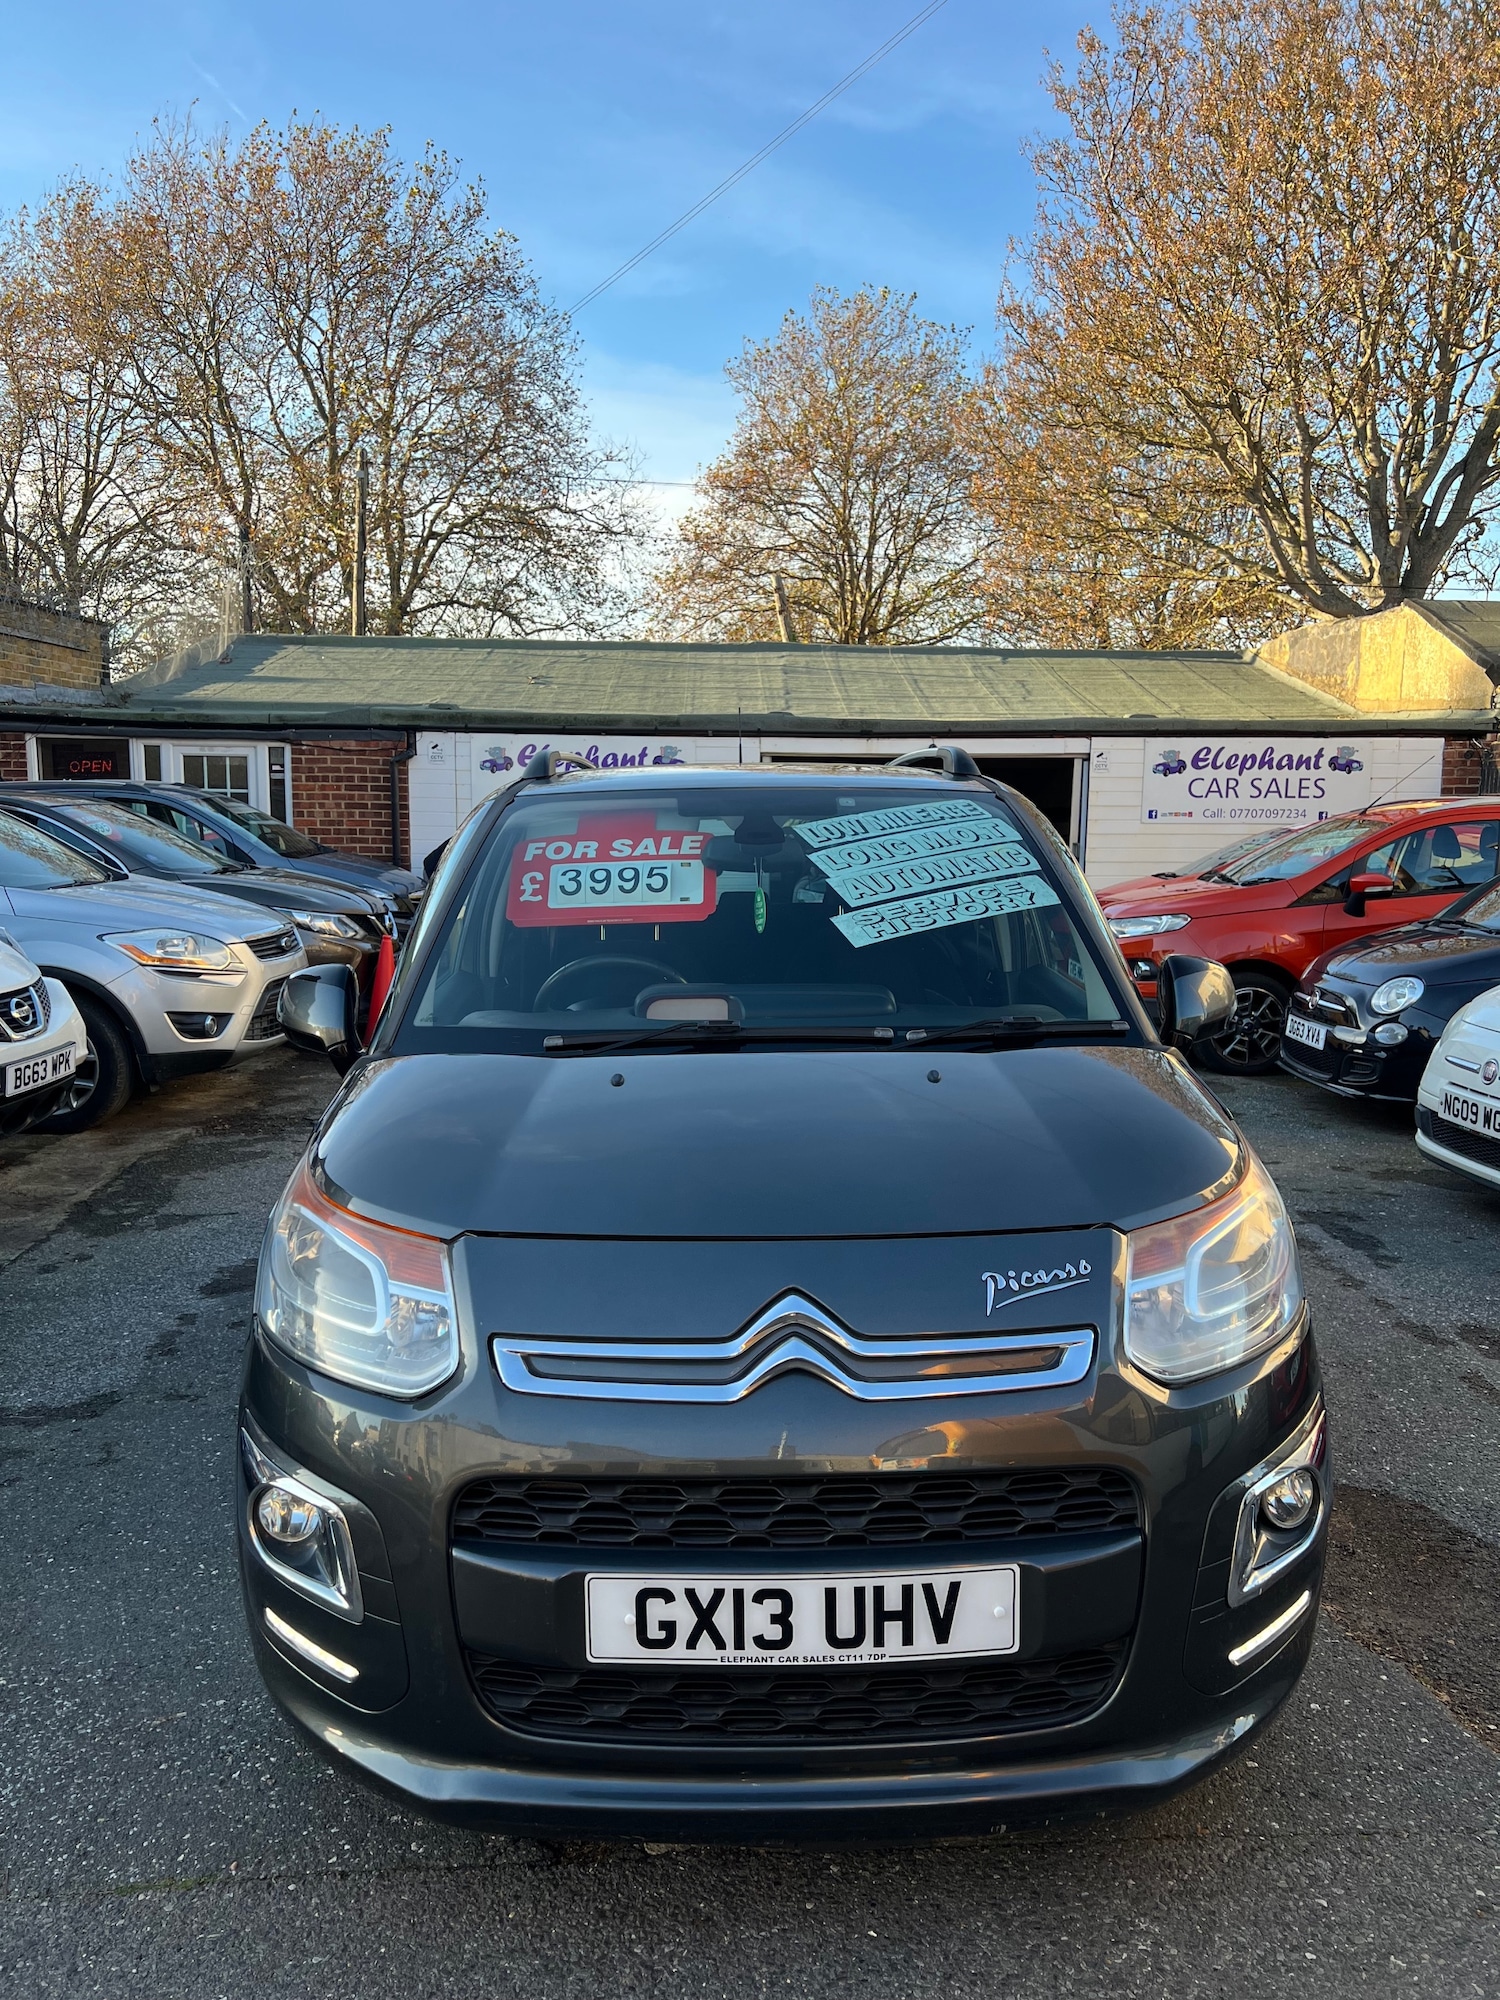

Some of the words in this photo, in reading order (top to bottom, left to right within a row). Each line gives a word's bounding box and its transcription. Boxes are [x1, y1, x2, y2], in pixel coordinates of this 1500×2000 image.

[69, 759, 112, 773] OPEN
[1190, 746, 1325, 776] Elephant
[1187, 777, 1240, 799] CAR
[1249, 777, 1326, 799] SALES
[803, 819, 866, 843] LOW
[864, 801, 988, 834] MILEAGE
[1202, 808, 1226, 819] Call:
[1230, 808, 1307, 819] 07707097234
[523, 840, 599, 862] FOR
[609, 835, 704, 858] SALE
[817, 838, 917, 870] LONG
[911, 821, 1008, 851] M.O.T
[519, 871, 545, 902] £
[558, 866, 669, 896] 3995
[842, 846, 1032, 900] AUTOMATIC
[851, 879, 1031, 926] SERVICE
[860, 890, 1037, 938] HISTORY
[14, 1059, 47, 1089] BG63
[51, 1050, 72, 1077] WPK
[1443, 1092, 1479, 1125] NG09
[634, 1586, 794, 1651] GX13
[823, 1580, 962, 1649] UHV
[720, 1655, 775, 1663] ELEPHANT
[778, 1655, 799, 1663] CAR
[802, 1654, 835, 1663] SALES
[838, 1654, 863, 1662] CT11
[867, 1653, 887, 1661] 7DP
